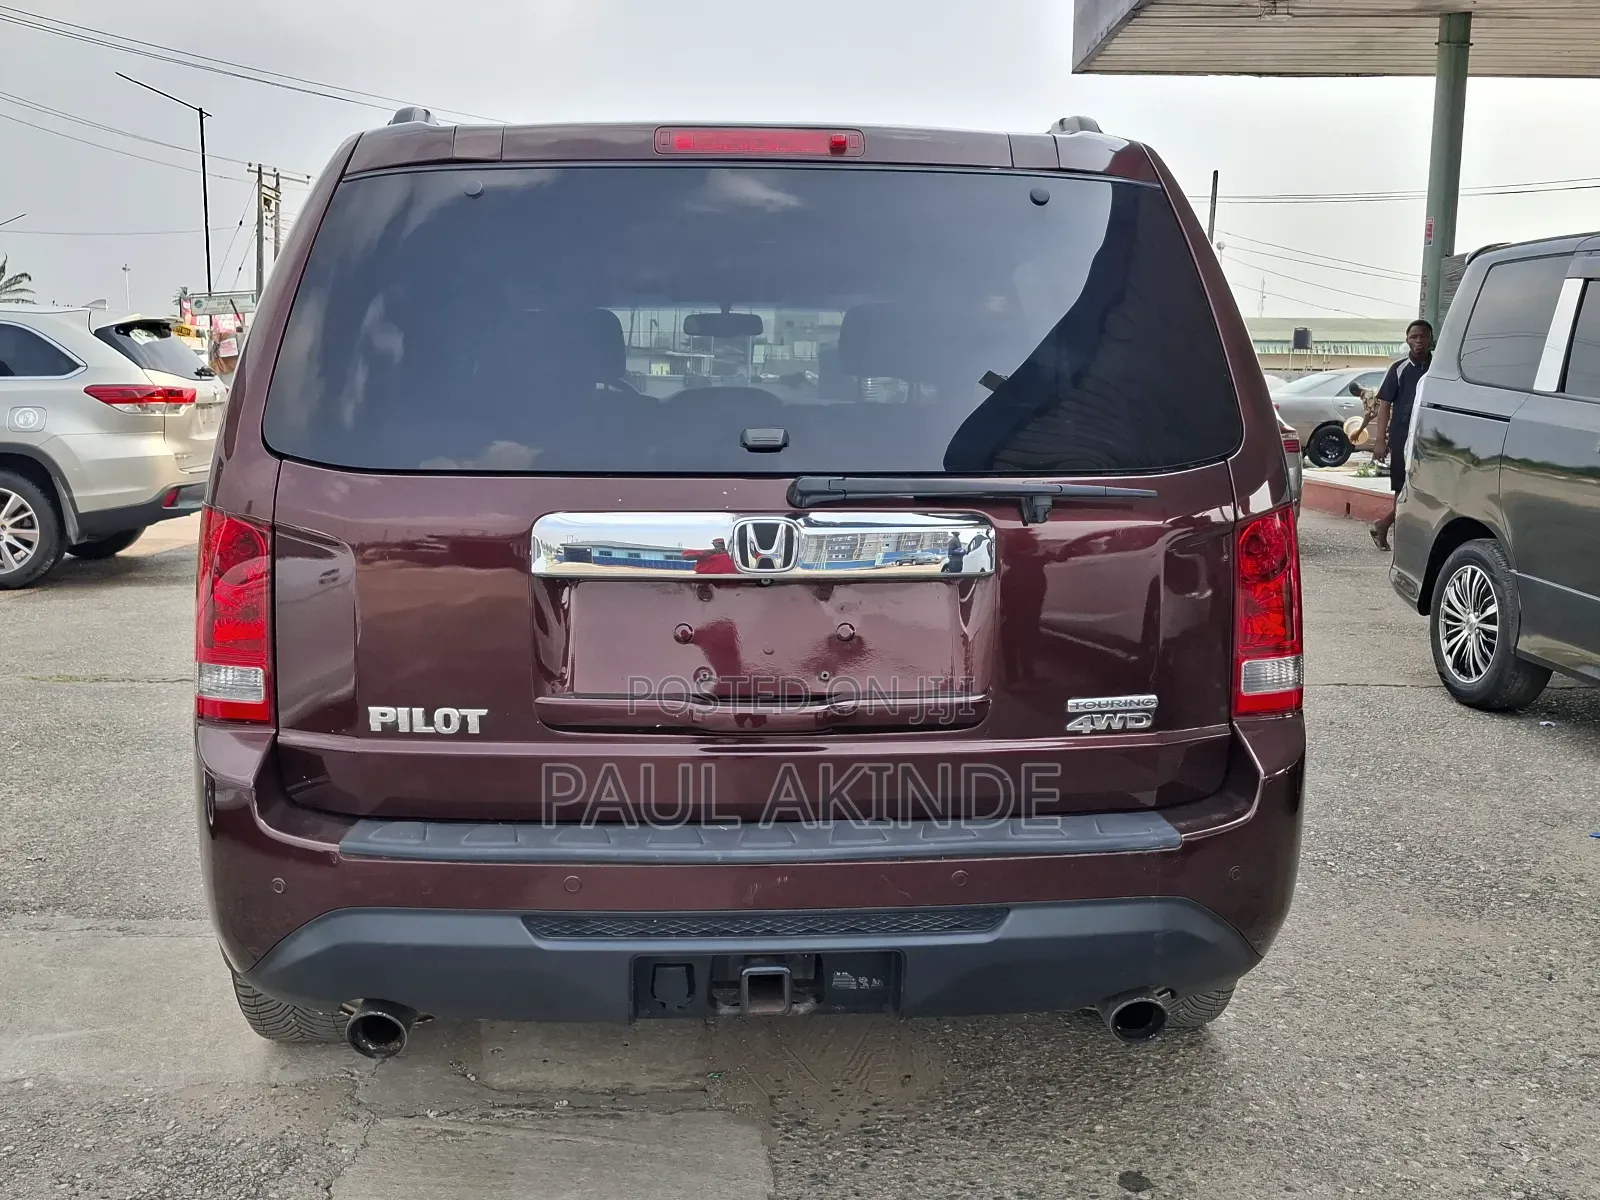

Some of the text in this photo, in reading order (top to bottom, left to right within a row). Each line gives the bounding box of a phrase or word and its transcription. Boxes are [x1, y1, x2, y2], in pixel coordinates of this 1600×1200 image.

[1069, 697, 1158, 711] TOURING
[367, 706, 489, 735] PILOT
[1066, 712, 1153, 734] 4WD
